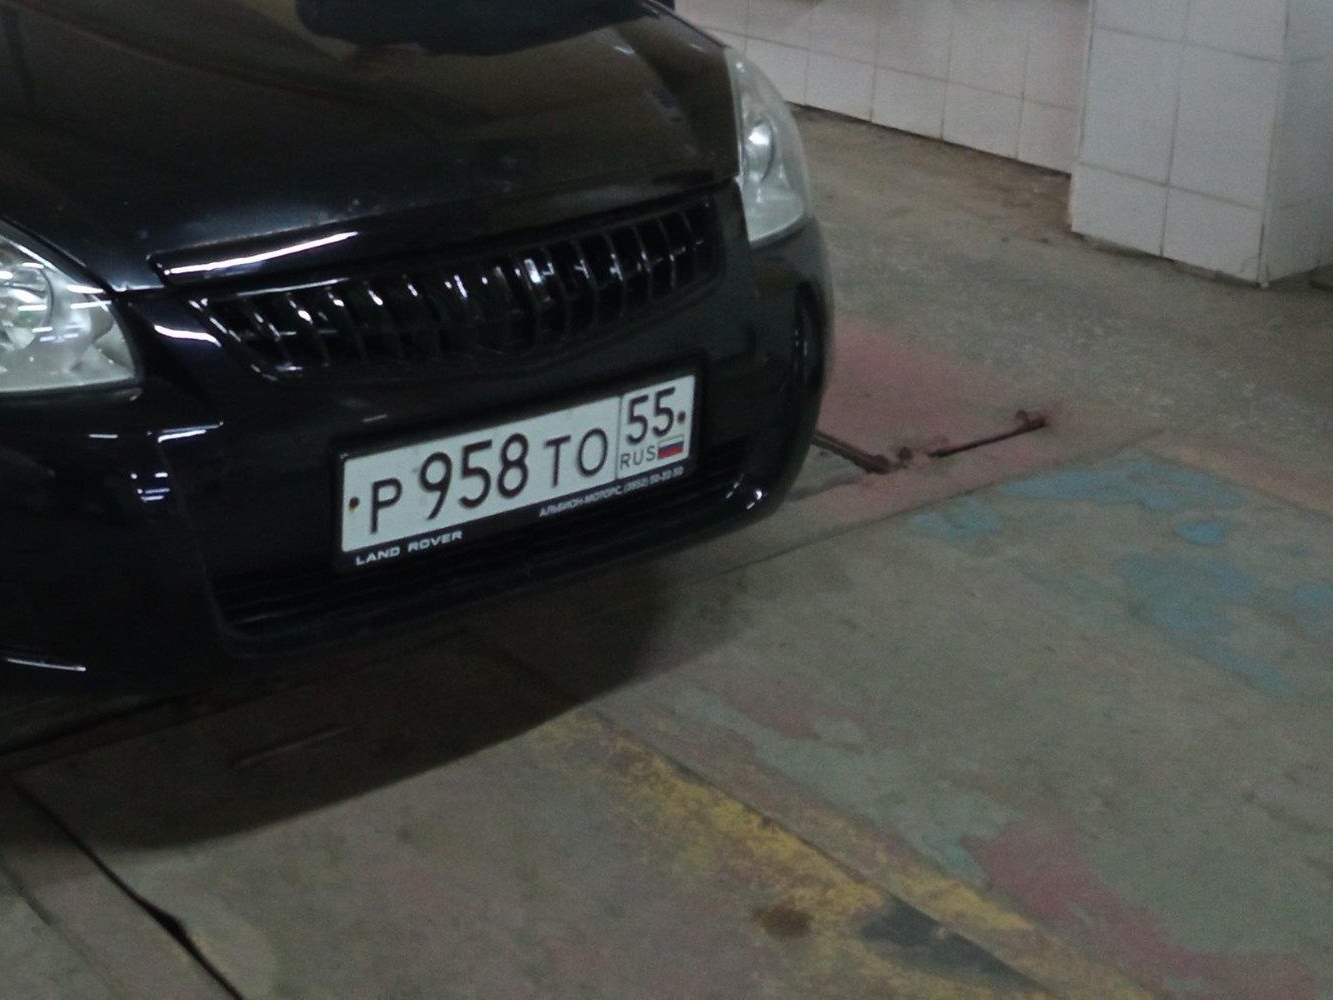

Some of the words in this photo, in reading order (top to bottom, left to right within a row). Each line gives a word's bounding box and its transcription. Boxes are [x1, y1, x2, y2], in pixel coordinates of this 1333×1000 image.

[369, 428, 609, 533] Р958ТО
[626, 387, 676, 445] 55
[620, 446, 657, 470] RUS
[355, 546, 401, 566] LAND
[408, 529, 463, 552] ROVER
